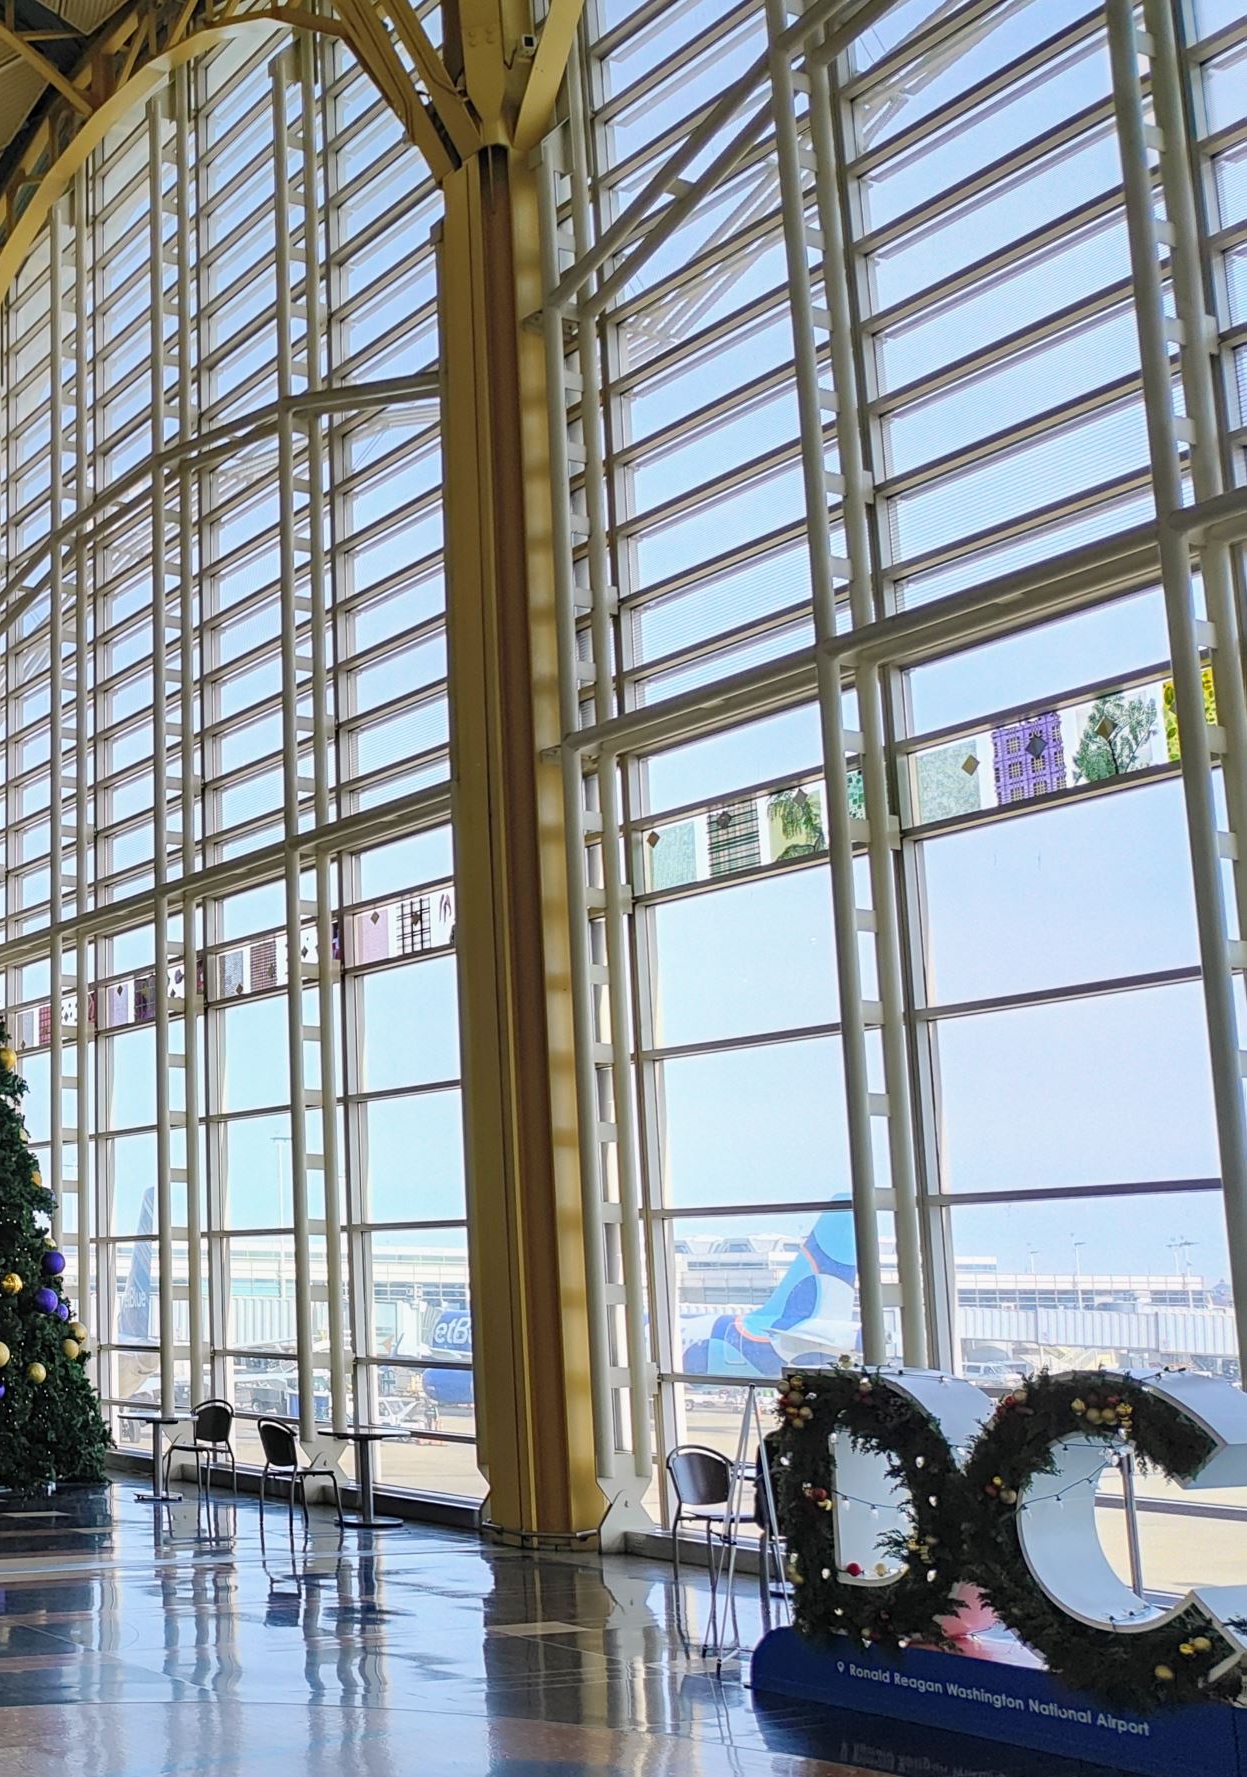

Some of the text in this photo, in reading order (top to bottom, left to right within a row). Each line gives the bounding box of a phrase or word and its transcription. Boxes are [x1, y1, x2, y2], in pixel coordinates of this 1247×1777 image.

[849, 1663, 1150, 1736] Ronald Reagan Washington National Airport
